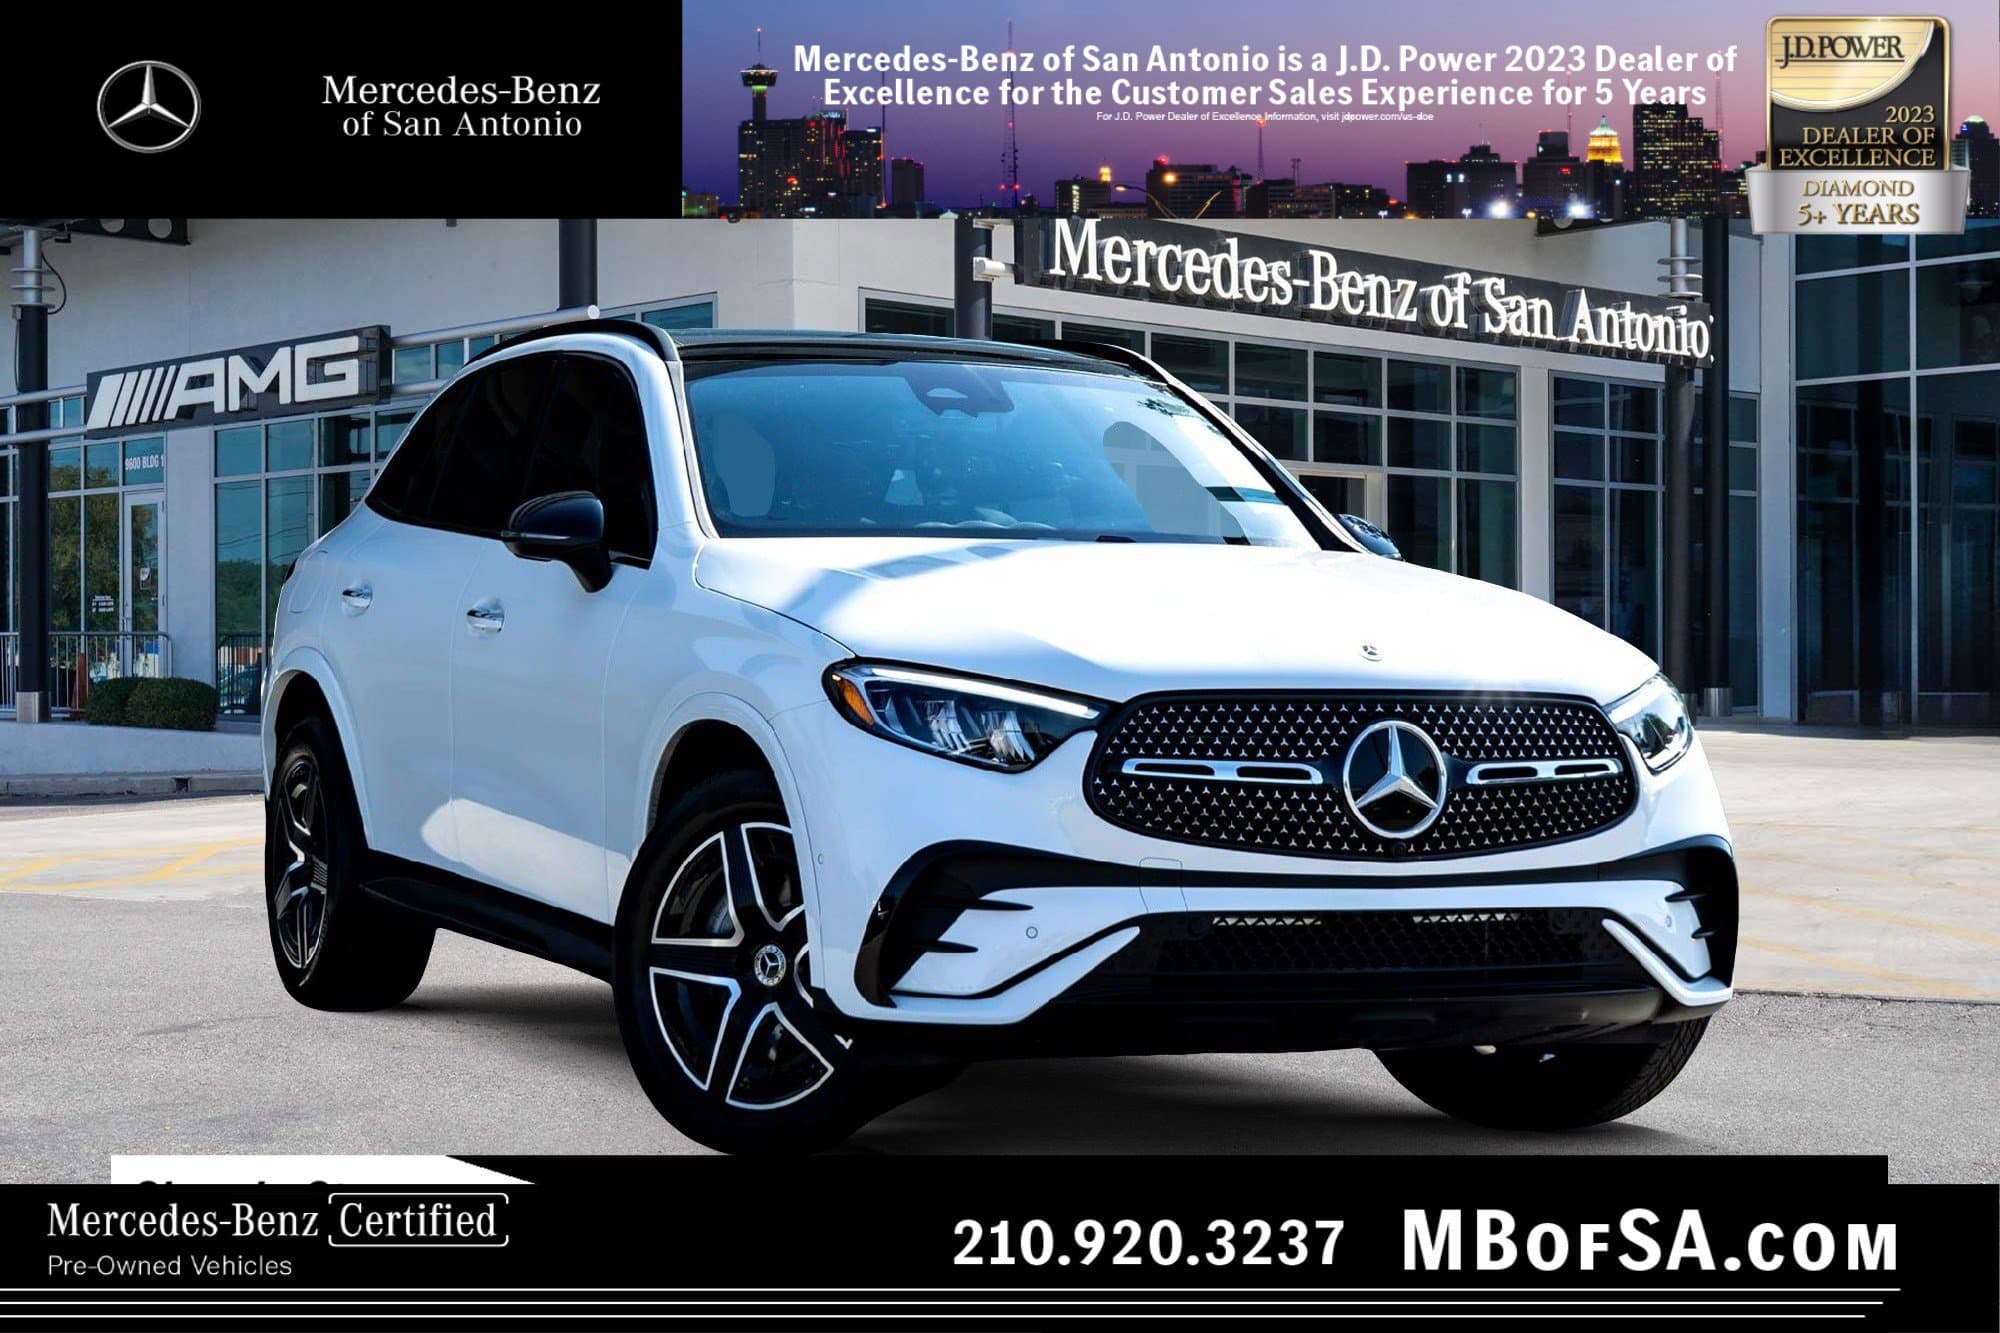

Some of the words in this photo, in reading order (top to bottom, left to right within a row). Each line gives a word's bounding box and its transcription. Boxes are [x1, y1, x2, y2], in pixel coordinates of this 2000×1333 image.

[1049, 218, 1418, 321] Mercedes-Benz
[1431, 271, 1472, 329] of
[1483, 277, 1557, 340] San
[1556, 288, 1710, 359] Antonio
[163, 335, 360, 420] AMG
